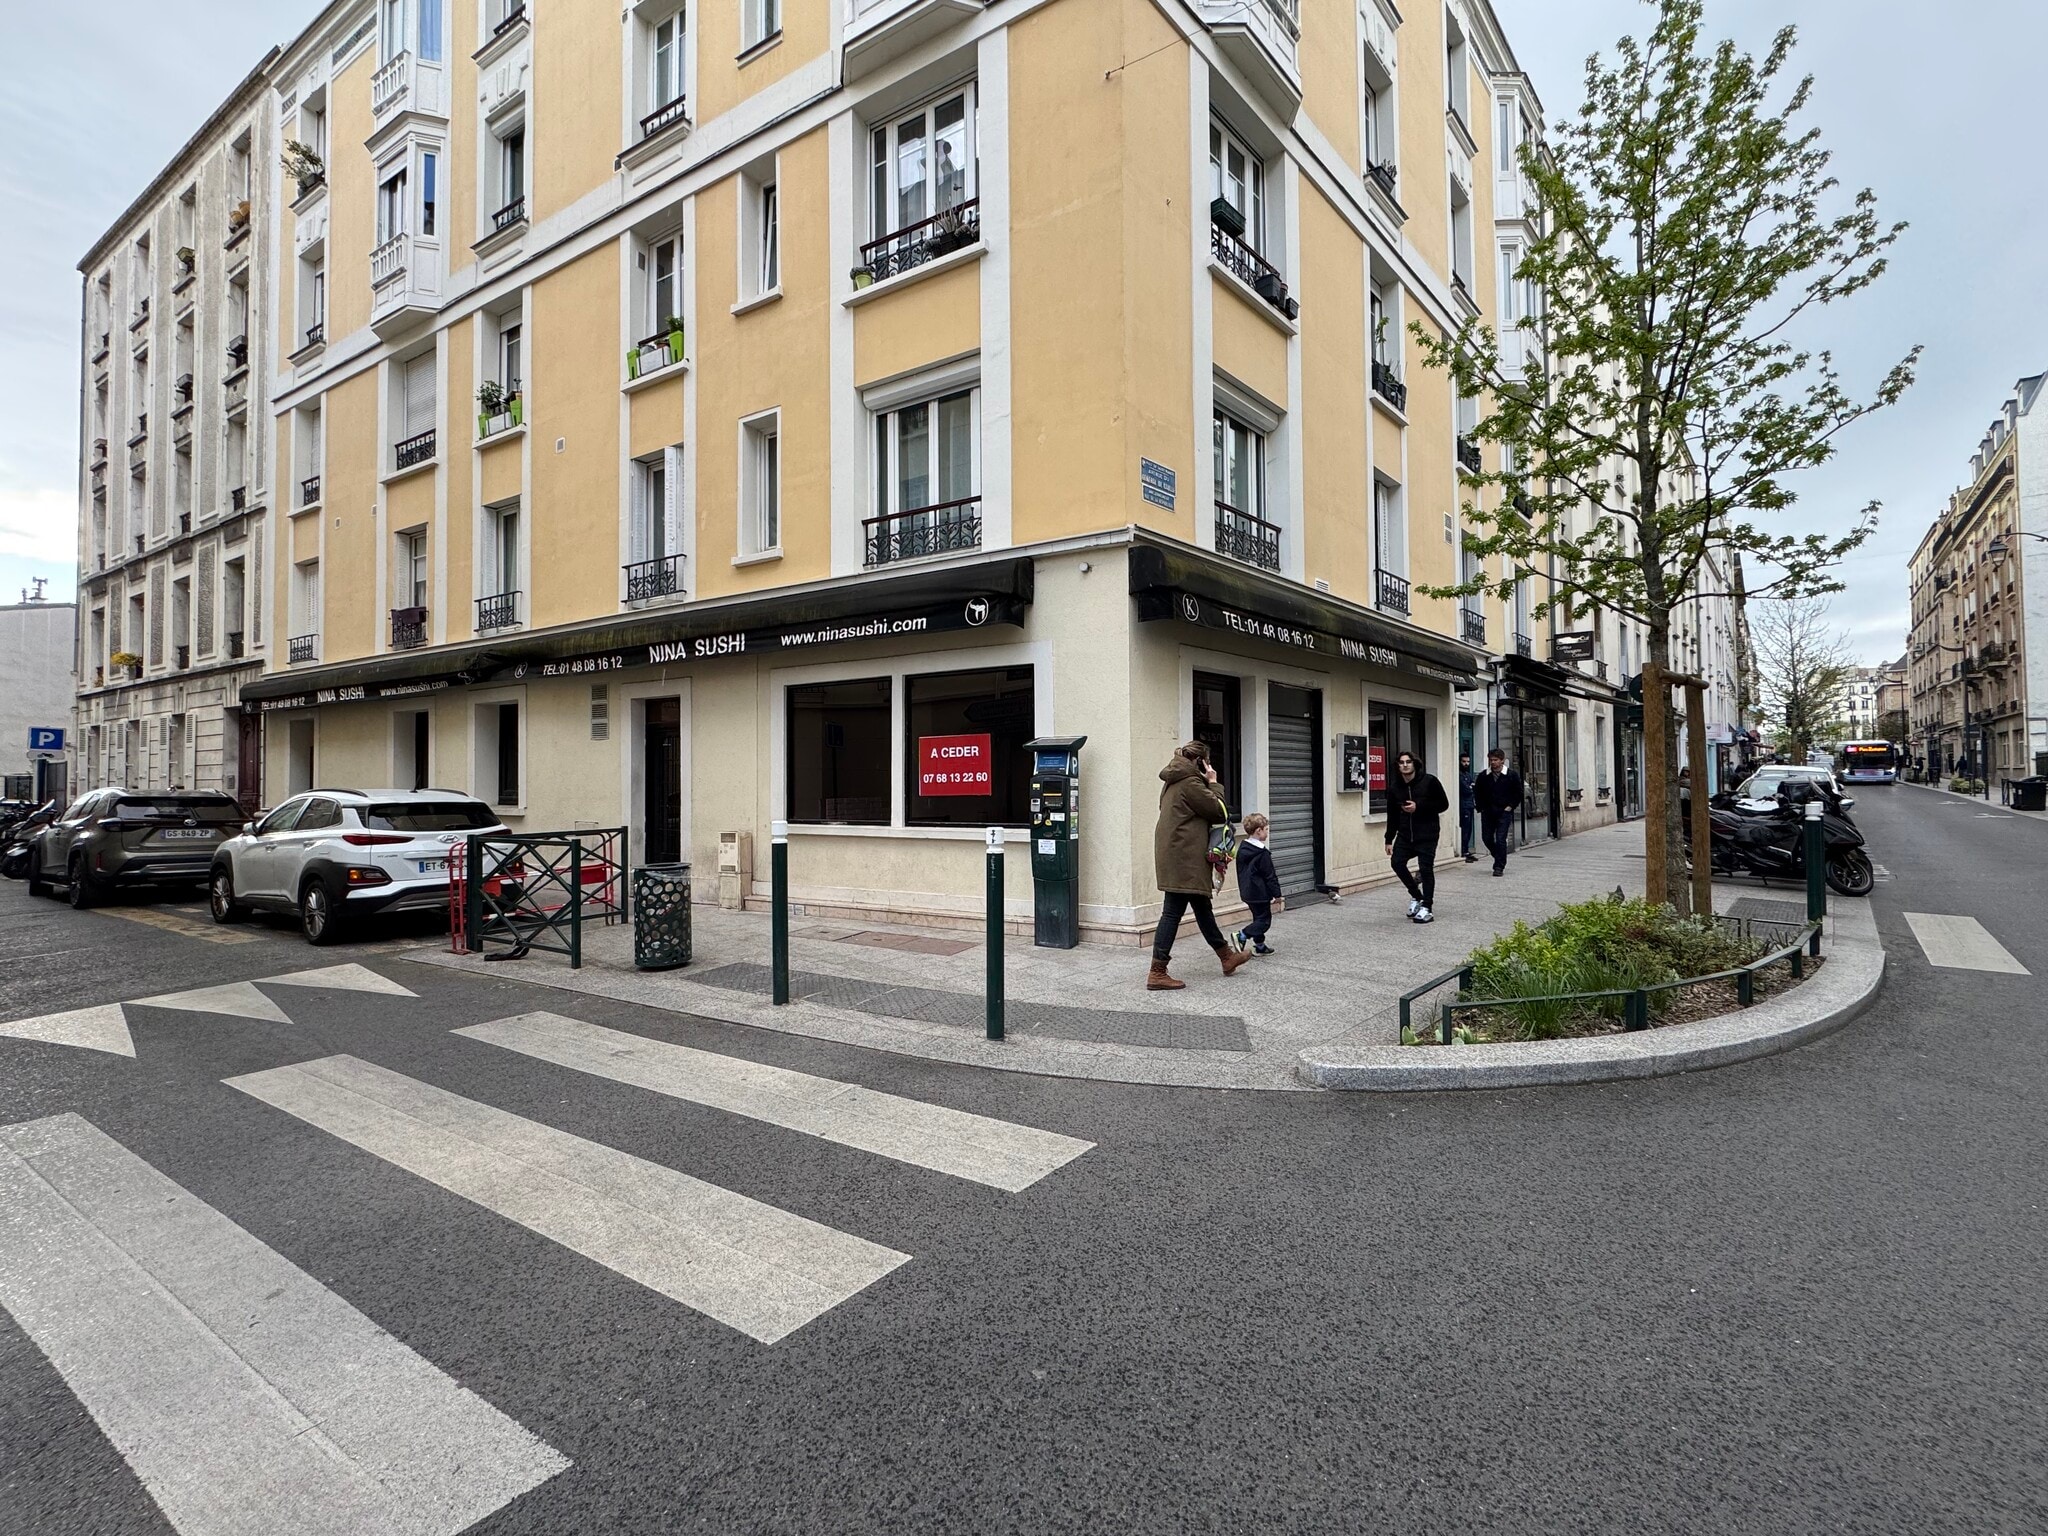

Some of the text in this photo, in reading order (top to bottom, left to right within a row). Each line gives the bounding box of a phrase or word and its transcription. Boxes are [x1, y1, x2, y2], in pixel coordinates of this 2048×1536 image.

[781, 617, 927, 647] www.ninasushi.com
[1222, 610, 1260, 636] TEL:01
[1277, 626, 1290, 643] 08
[1291, 629, 1302, 646] 16
[1303, 632, 1315, 649] 12
[649, 632, 746, 664] NINA SUSHI
[1340, 637, 1398, 668] NINA SUSHI
[543, 655, 622, 676] TEL:01 48 08 16 12
[317, 686, 365, 704] NINA SUSHI
[380, 679, 449, 697] www.ninasushi.com
[38, 731, 55, 746] P
[930, 745, 979, 758] A CEDER
[923, 771, 988, 783] 07 68 13 22 60
